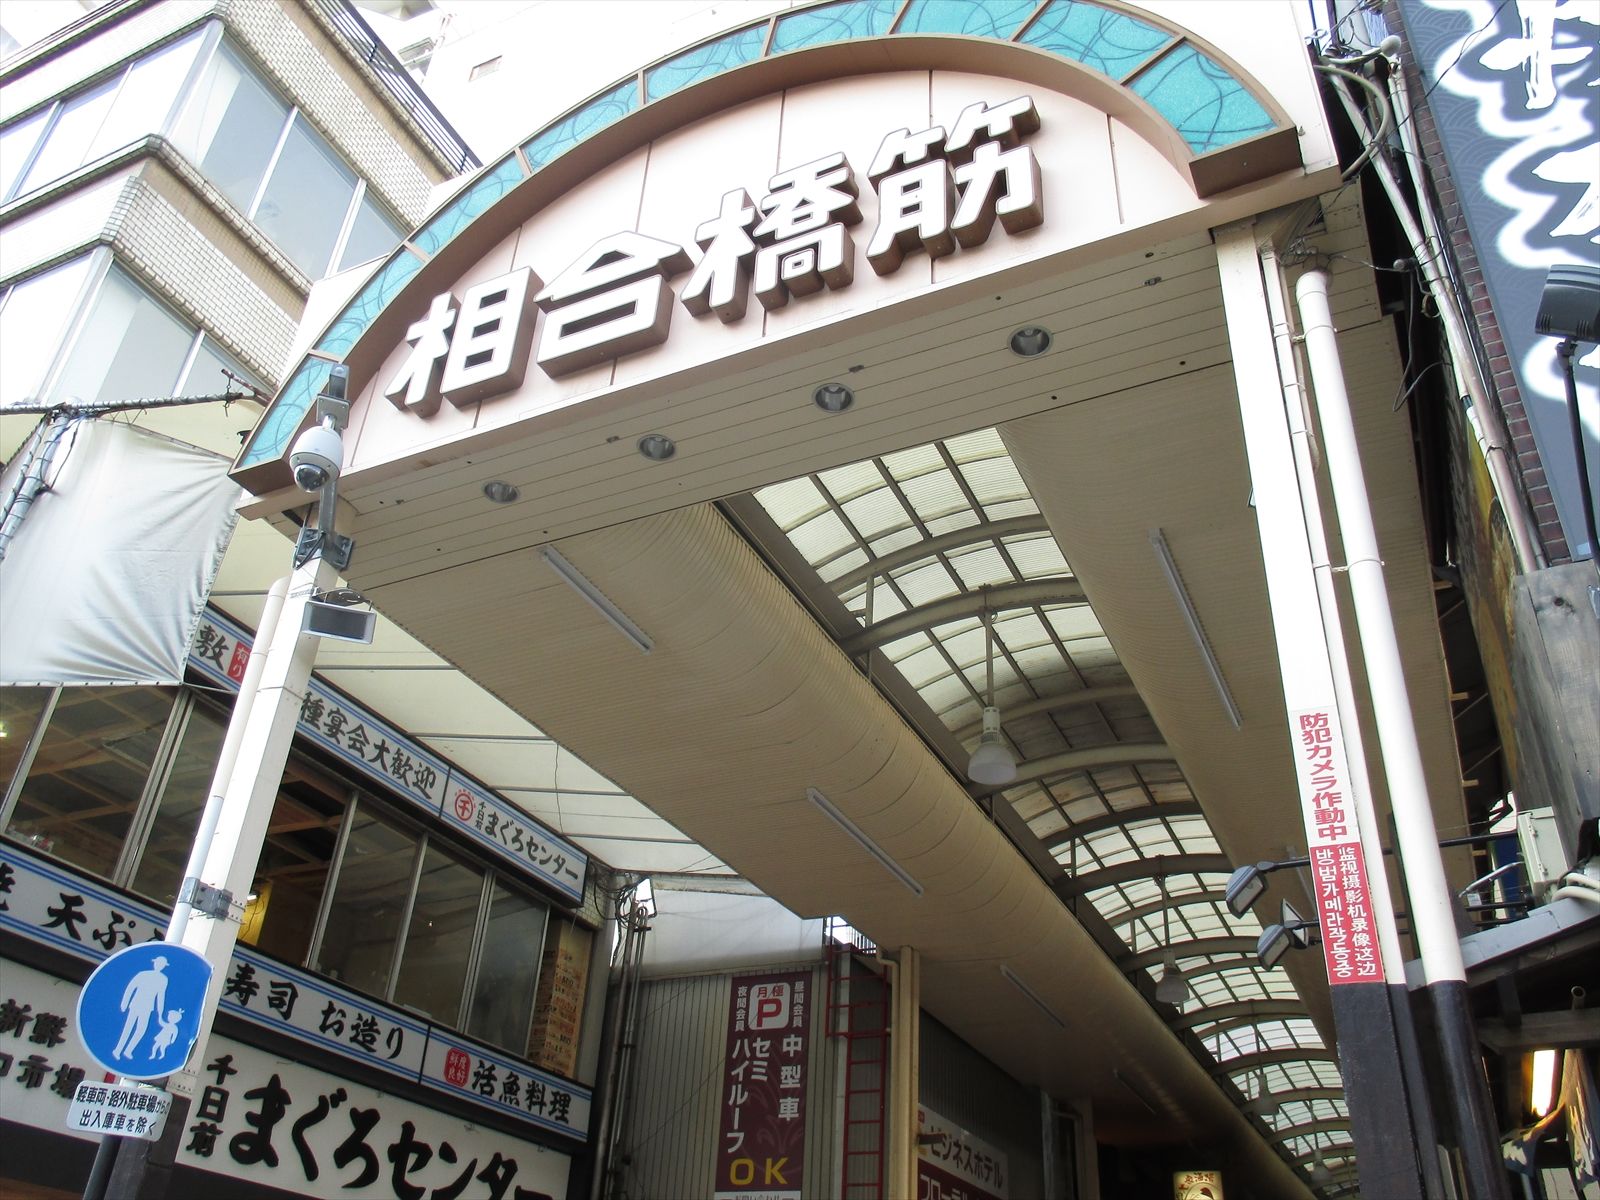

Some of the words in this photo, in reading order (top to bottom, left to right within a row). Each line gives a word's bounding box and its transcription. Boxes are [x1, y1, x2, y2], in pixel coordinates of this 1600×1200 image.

[384, 95, 1044, 418] 相合橋筋
[1300, 712, 1347, 840] 防犯カメラ作動中
[485, 811, 579, 880] まぐろセンター
[42, 893, 165, 950] 天ぷ
[1316, 849, 1353, 978] 방범카메라작동중
[1338, 846, 1377, 977] 监视摄影机录像这边
[226, 963, 299, 1020] 寿司
[318, 1000, 405, 1060] お造り
[757, 998, 782, 1028] P
[472, 1060, 572, 1124] 活魚料理
[727, 1038, 751, 1154] ハイルーフ
[751, 1037, 771, 1082] セミ
[778, 1034, 802, 1121] 中型車
[80, 1108, 157, 1136] 出入庫車を除く
[186, 1054, 238, 1158] 千日前
[229, 1073, 553, 1200] まぐろセンター
[730, 1157, 788, 1186] OK
[930, 1126, 1003, 1189] ビジネスホテル
